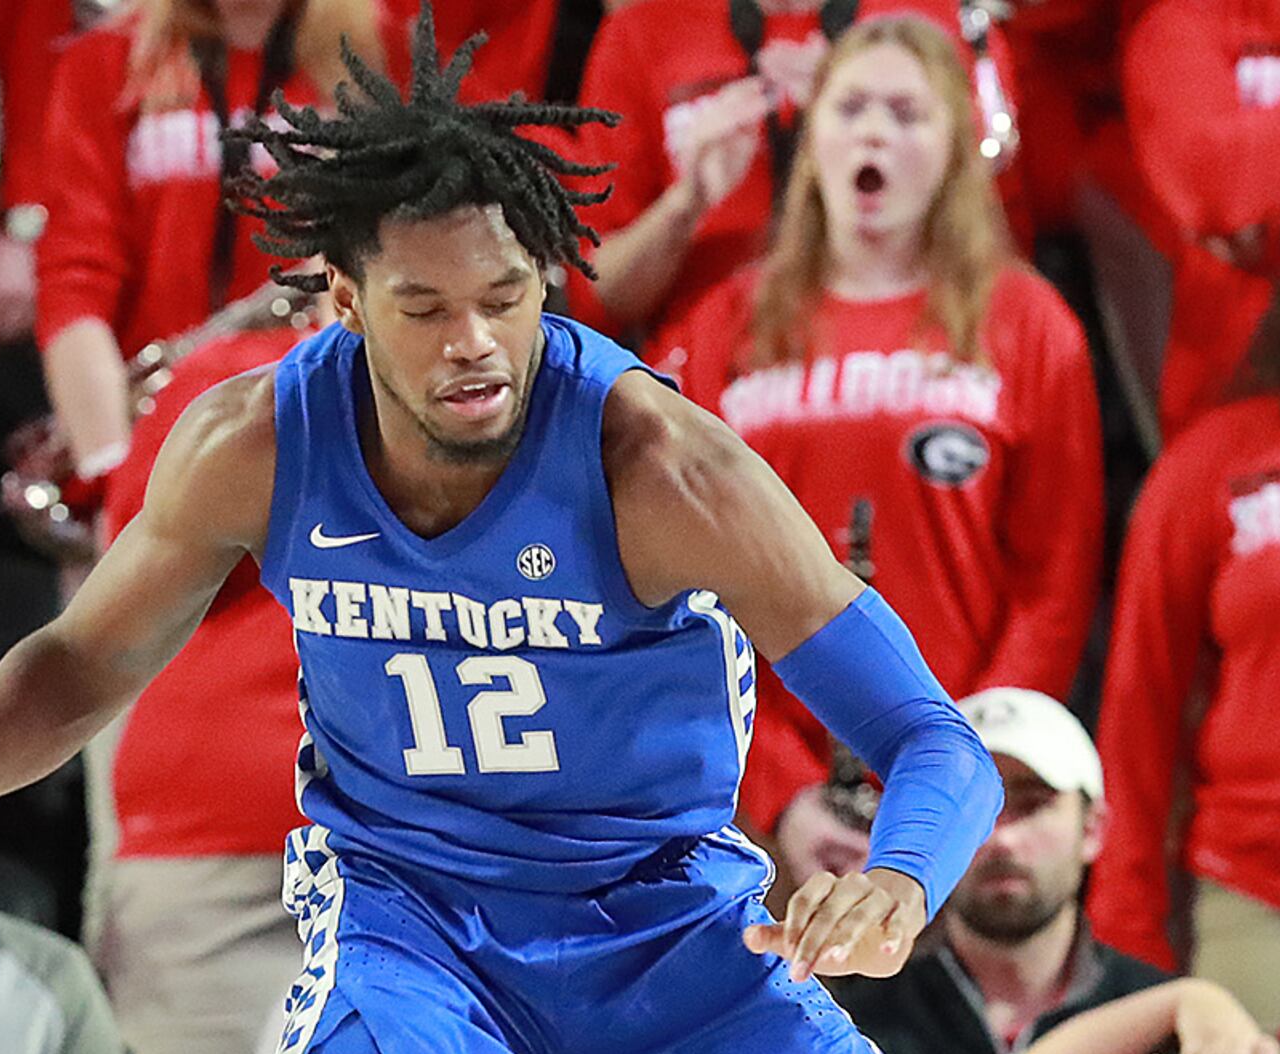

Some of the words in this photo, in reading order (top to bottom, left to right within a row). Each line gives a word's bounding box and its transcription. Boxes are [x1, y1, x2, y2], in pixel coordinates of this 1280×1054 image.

[519, 546, 553, 579] SEC
[288, 576, 605, 651] KENTUCKY
[384, 653, 561, 776] 12
